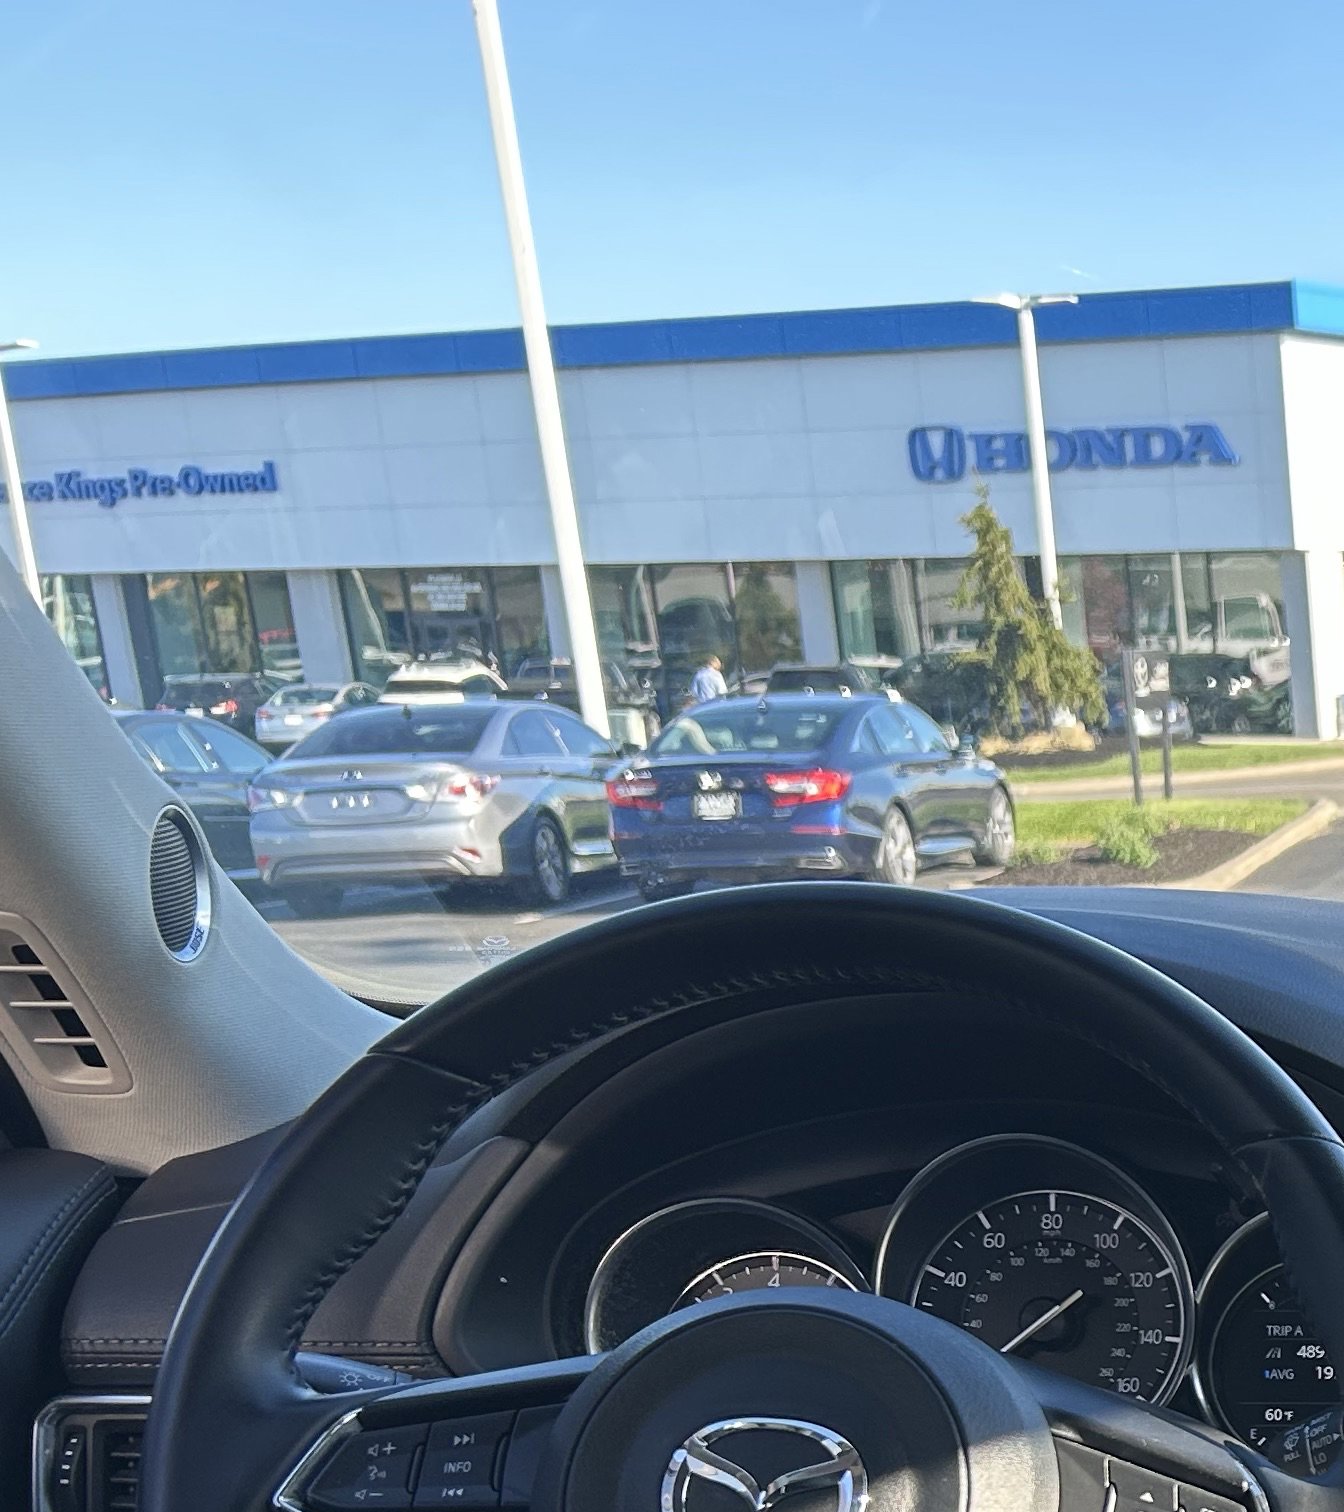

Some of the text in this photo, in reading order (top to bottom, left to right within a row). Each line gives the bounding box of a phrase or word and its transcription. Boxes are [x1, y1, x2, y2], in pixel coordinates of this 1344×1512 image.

[968, 424, 1241, 474] HONDA
[54, 470, 128, 508] Kings
[127, 460, 278, 498] Pre-Owned
[1040, 1213, 1063, 1230] 80
[983, 1232, 1006, 1249] 60
[1094, 1233, 1120, 1249] 100
[1034, 1248, 1050, 1257] 120
[1060, 1248, 1076, 1257] 140
[1009, 1257, 1025, 1266] 100
[767, 1272, 781, 1288] 4
[943, 1271, 967, 1288] 40
[989, 1272, 1004, 1282] 80
[1129, 1272, 1153, 1288] 120
[975, 1293, 989, 1303] 60
[969, 1319, 983, 1328] 40
[1115, 1322, 1132, 1333] 220
[1138, 1328, 1163, 1345] 140
[1265, 1325, 1304, 1337] TRIP A
[1110, 1347, 1126, 1358] 240
[1270, 1368, 1295, 1380] AVG
[1116, 1377, 1141, 1393] 160
[1249, 1428, 1259, 1440] E
[1311, 1434, 1333, 1451] AUTO
[1313, 1452, 1328, 1465] LO
[443, 1460, 473, 1474] INFO
